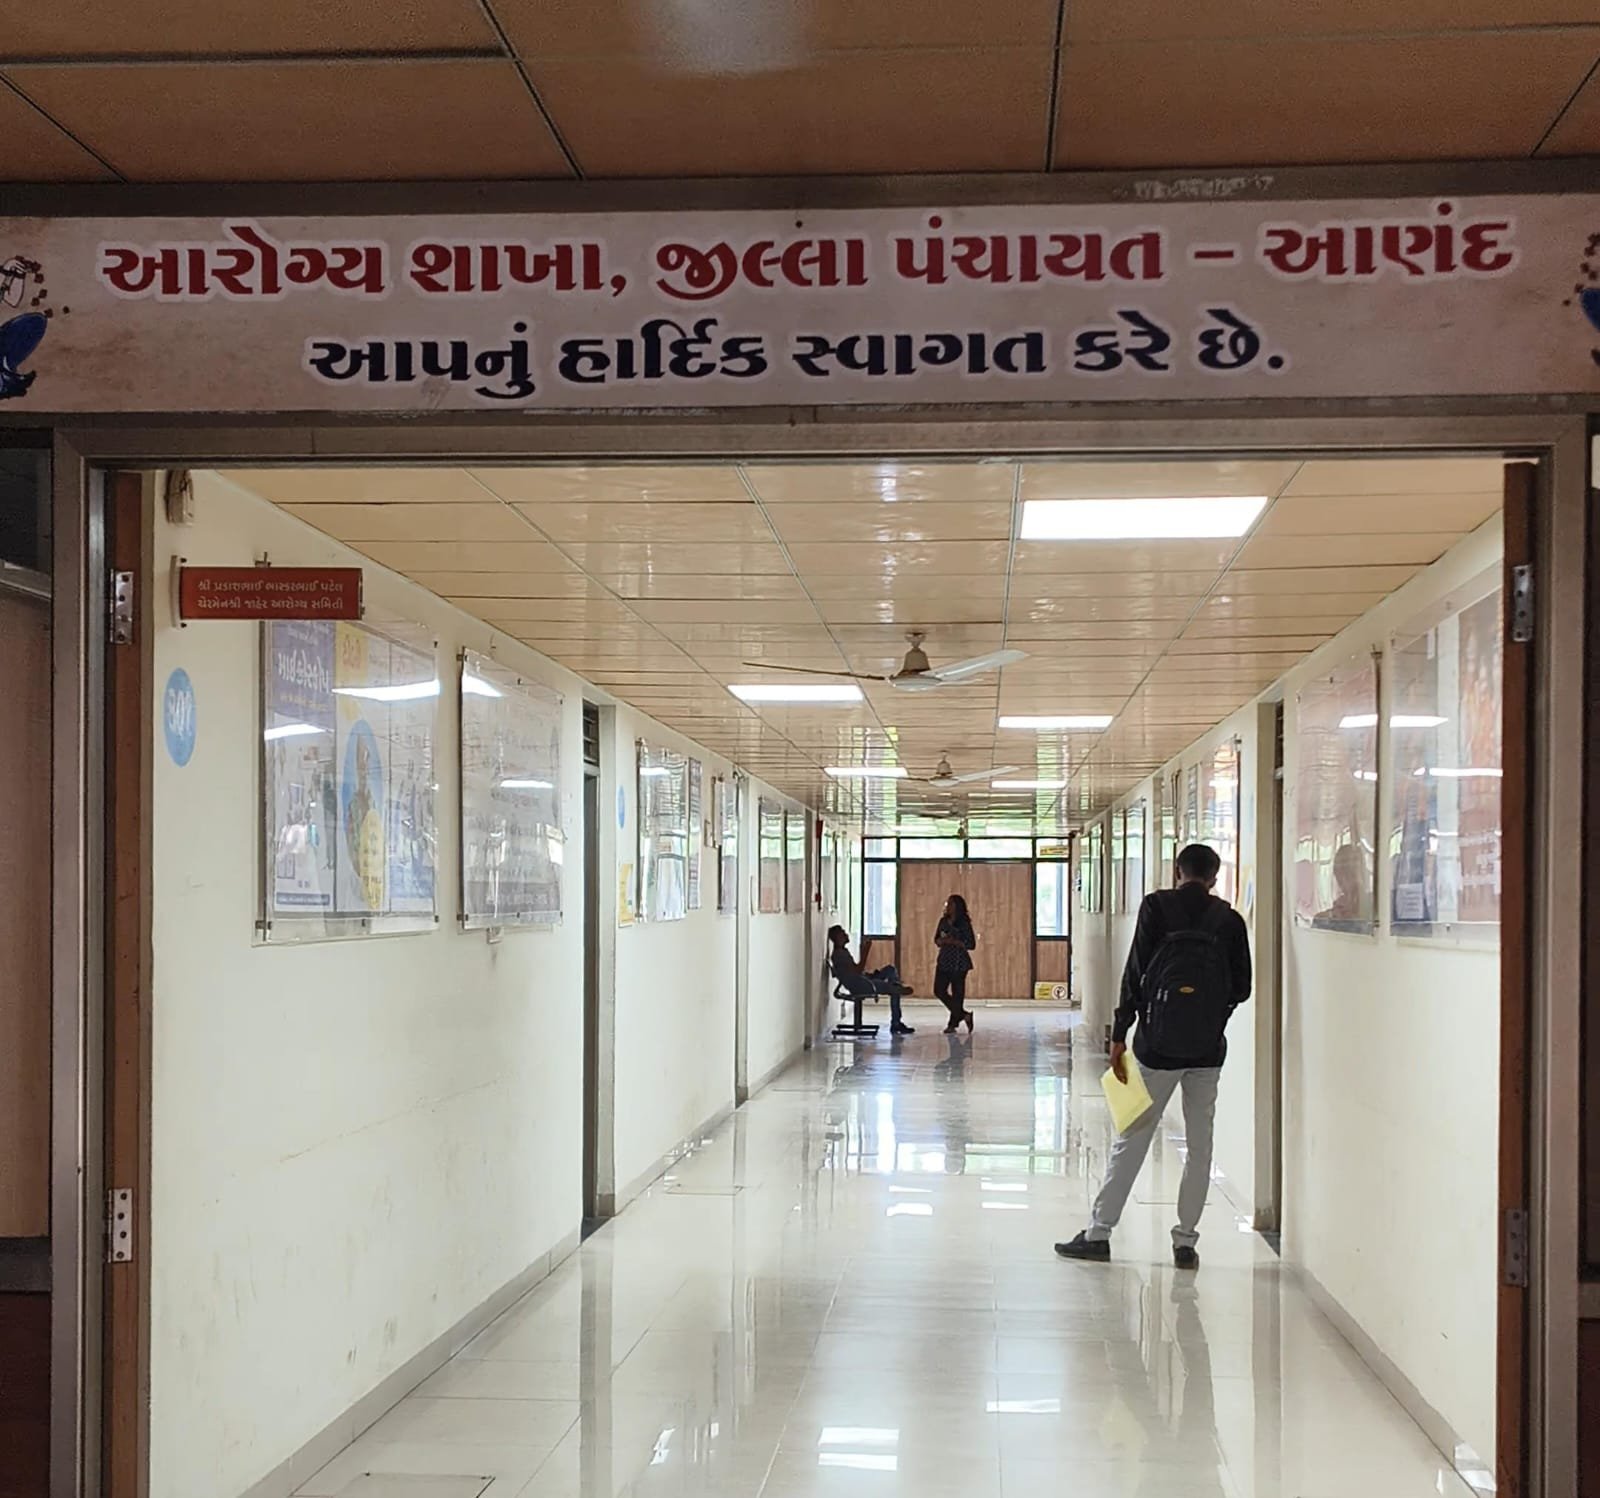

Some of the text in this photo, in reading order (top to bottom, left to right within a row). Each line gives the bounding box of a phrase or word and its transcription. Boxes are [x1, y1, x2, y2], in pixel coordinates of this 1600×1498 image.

[102, 226, 385, 295] આરોગ્ય
[409, 243, 627, 297] શાખા,
[656, 239, 869, 301] જીલ્લા
[895, 215, 1164, 284] પંચાયત
[1263, 203, 1513, 277] આણંદ
[309, 308, 1284, 400] આપનું હાર્દિક સ્વાગત કરે છે.
[197, 579, 211, 591] શ્રી
[320, 579, 344, 592] પટેલ
[244, 595, 268, 610] જાહેર
[271, 595, 308, 609] આરોગ્ય
